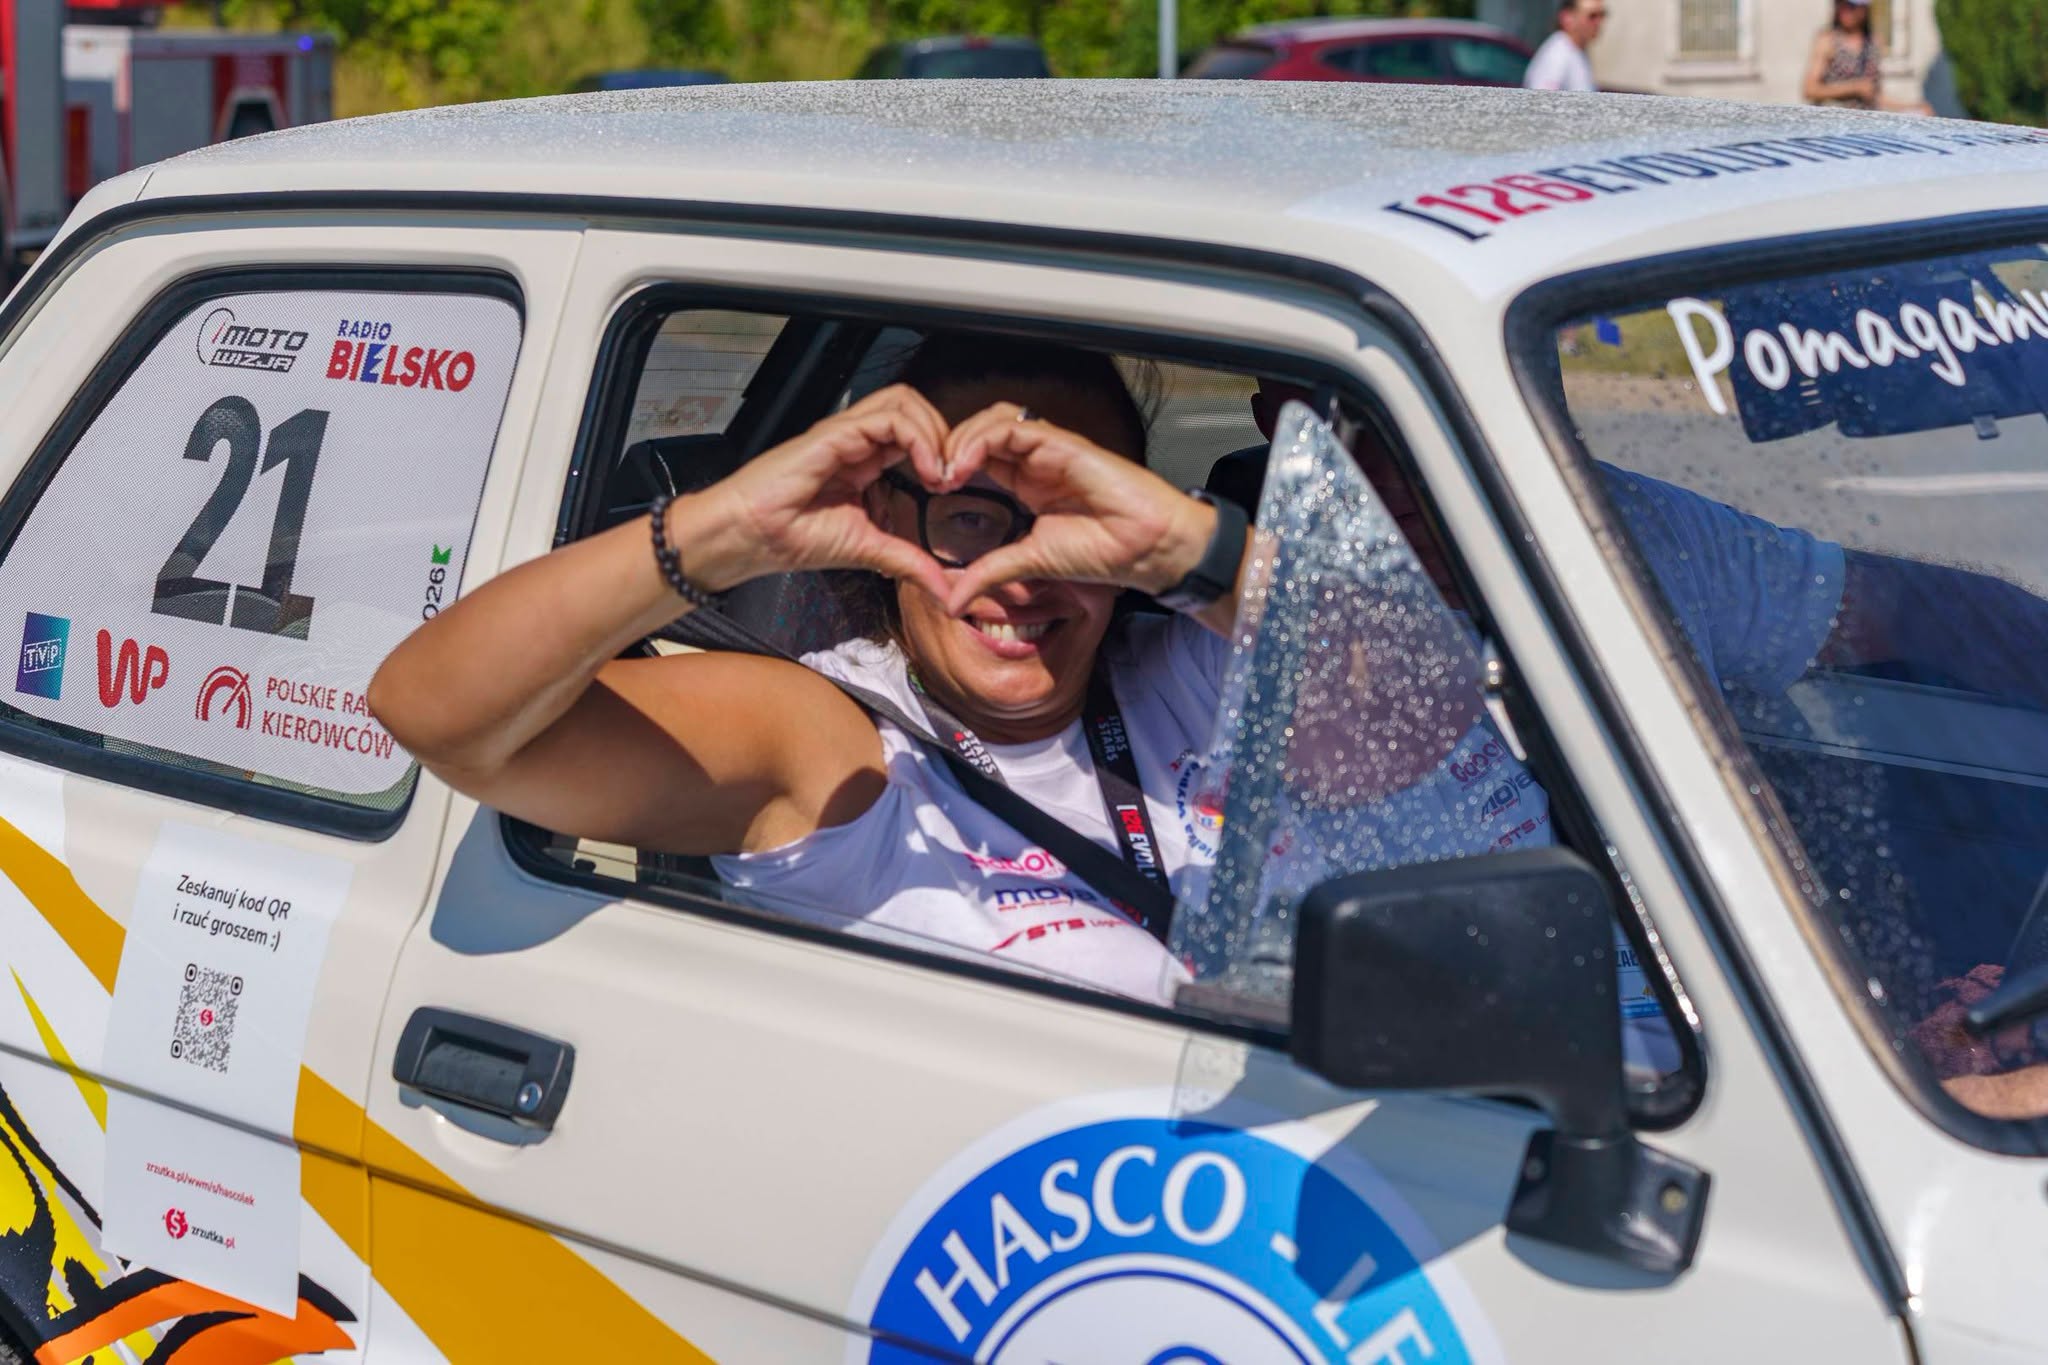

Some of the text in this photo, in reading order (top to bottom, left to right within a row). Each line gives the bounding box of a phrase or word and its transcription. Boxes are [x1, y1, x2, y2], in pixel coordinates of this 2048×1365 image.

[337, 319, 392, 341] RADIO
[209, 349, 297, 373] WIZJA
[326, 339, 475, 392] BIELSKO
[150, 395, 331, 641] 21
[96, 628, 170, 708] WP
[266, 677, 374, 717] POLSKIE RA
[261, 710, 395, 760] KIEROWCÓW
[1098, 722, 1119, 762] STARS
[1109, 715, 1128, 752] STARS
[176, 874, 291, 921] Zeskanuj kod QR
[173, 902, 281, 952] i rzuć groszem :)
[191, 1226, 236, 1249] zrzutka.pl
[913, 1145, 1247, 1344] HASCO
